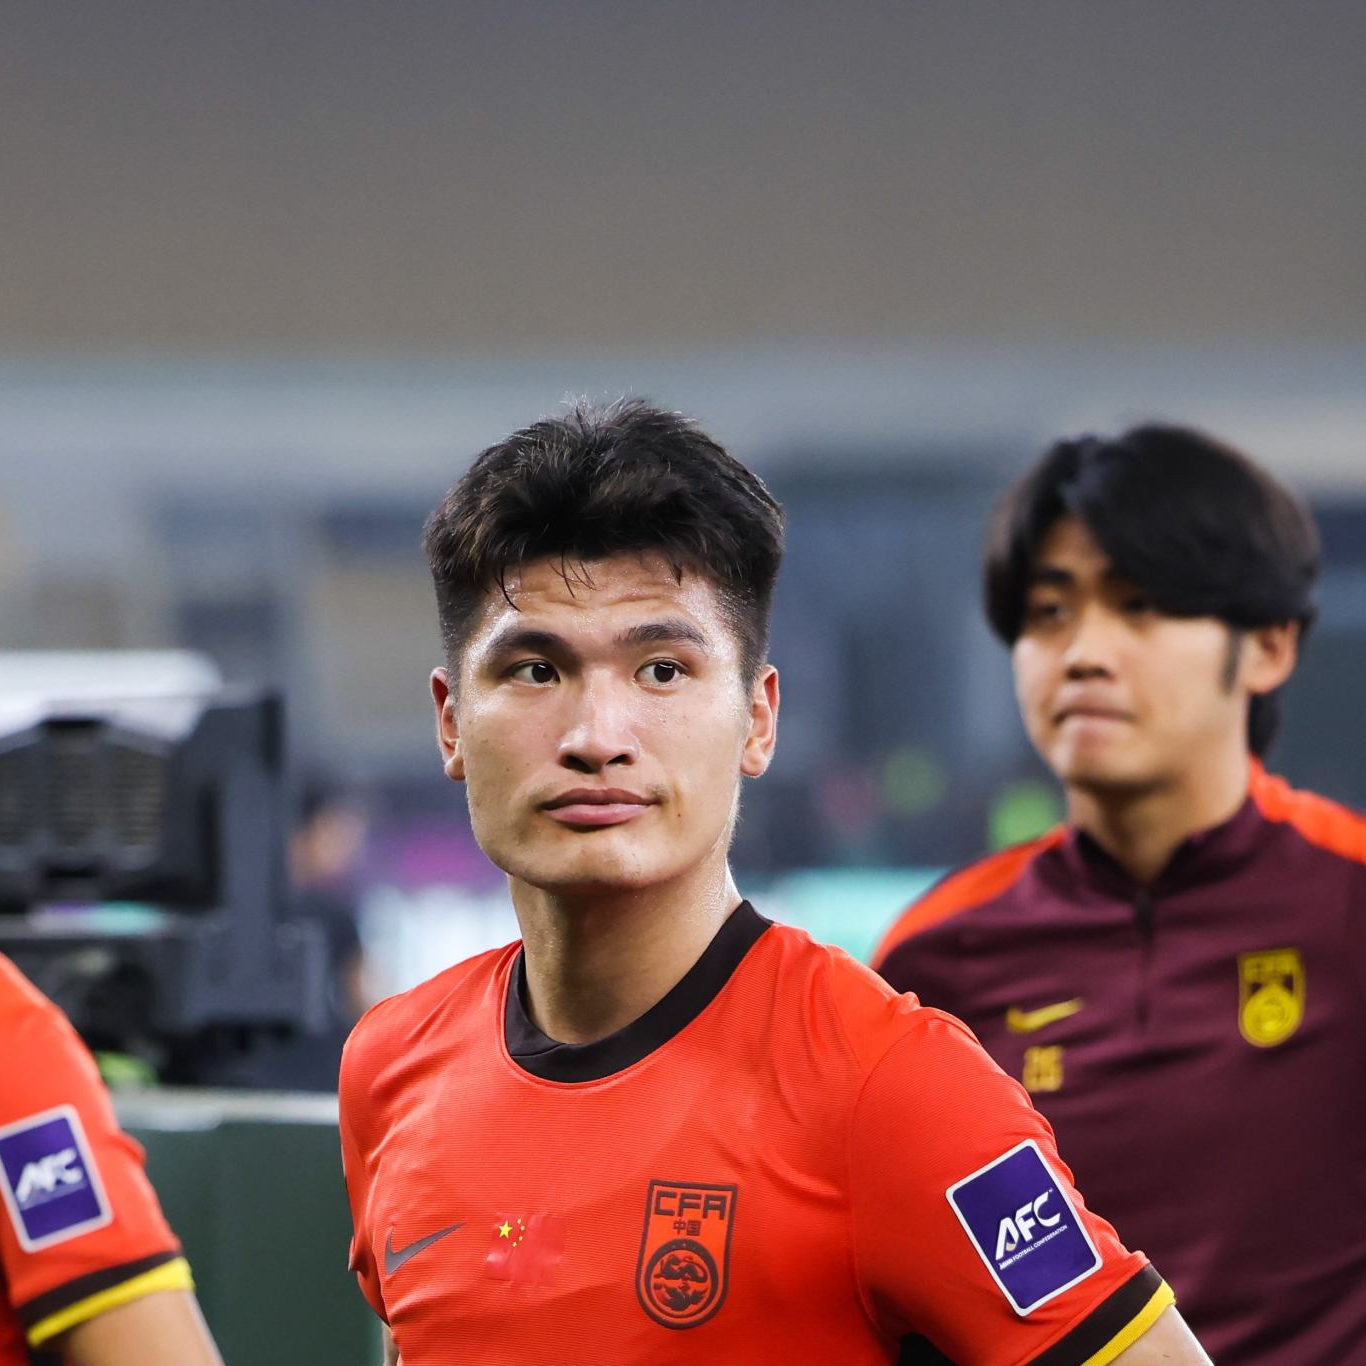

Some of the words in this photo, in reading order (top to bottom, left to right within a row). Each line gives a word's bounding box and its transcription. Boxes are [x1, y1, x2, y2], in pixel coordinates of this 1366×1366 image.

[16, 1148, 84, 1203] AFC
[654, 1190, 728, 1221] CFA
[672, 1218, 702, 1237] 中国
[995, 1191, 1061, 1261] AFC
[1012, 1245, 1035, 1261] FOOTBALL
[1033, 1224, 1068, 1248] CONFEDERATION
